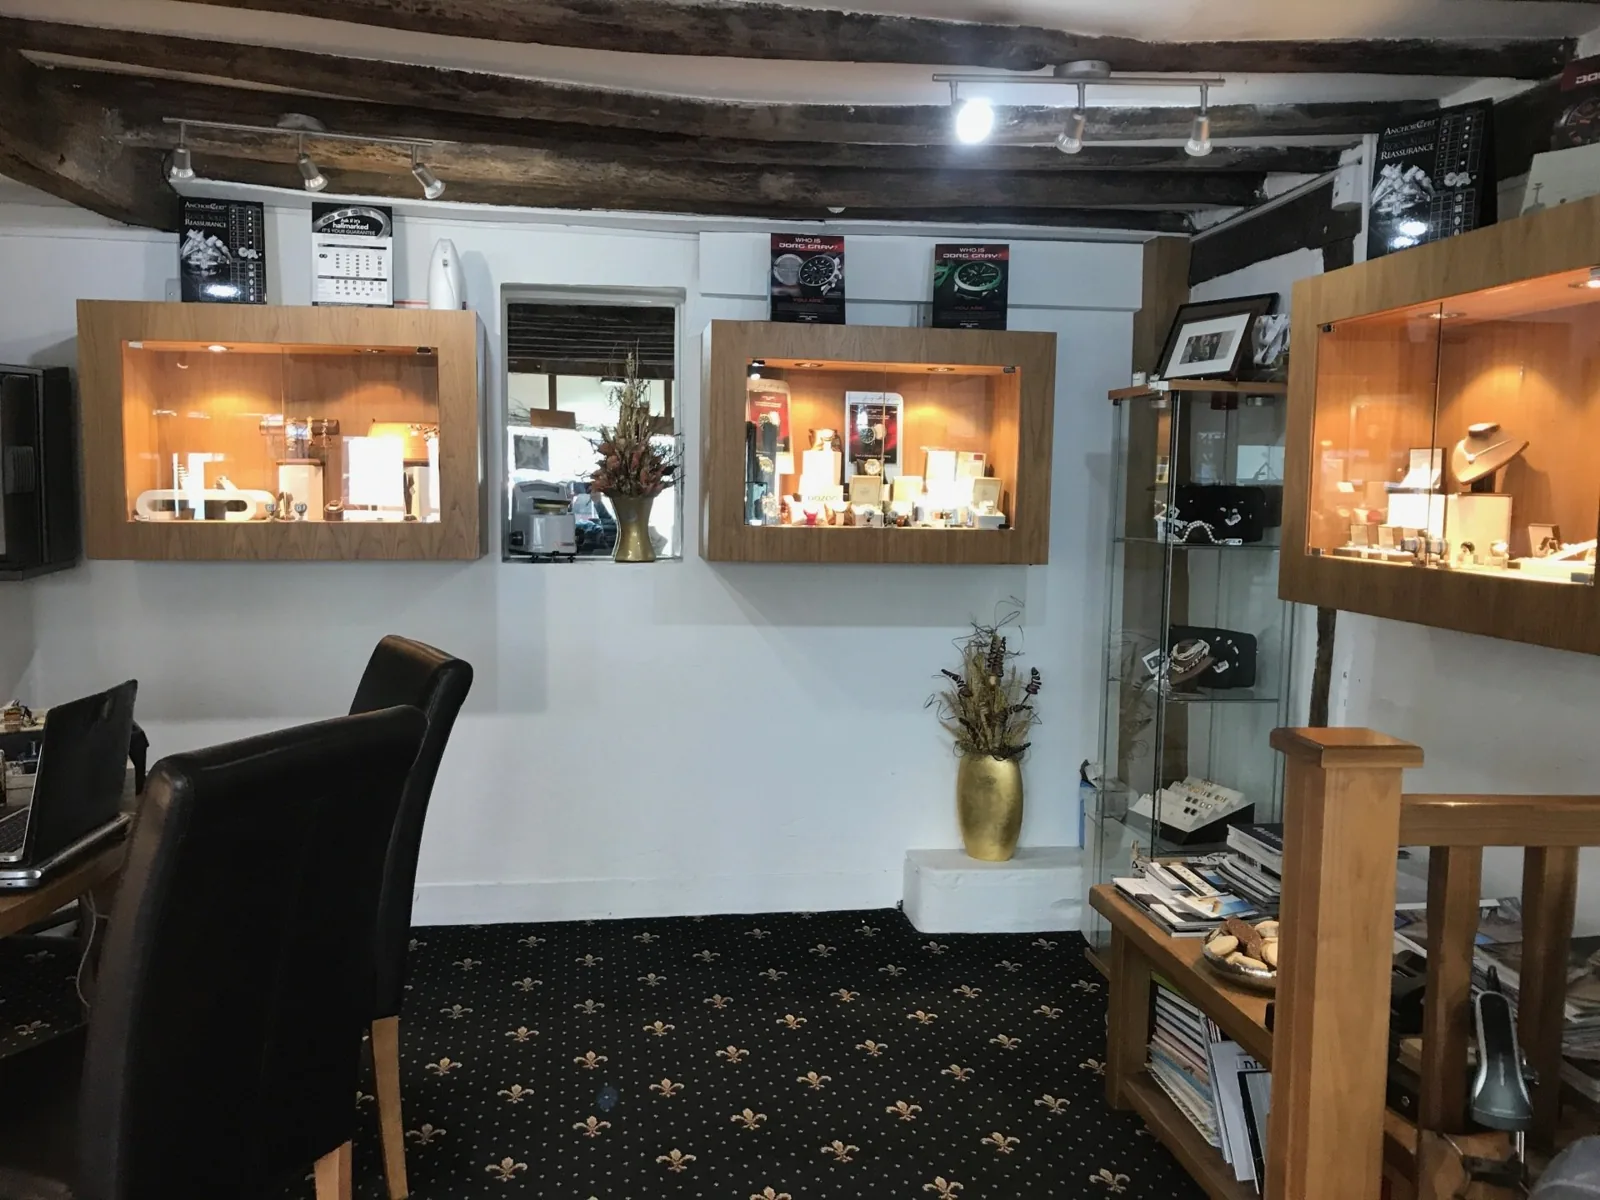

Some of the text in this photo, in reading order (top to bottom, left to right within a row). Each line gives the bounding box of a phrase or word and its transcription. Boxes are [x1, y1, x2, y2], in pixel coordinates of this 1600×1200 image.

[1381, 143, 1434, 160] REASSURANCE
[185, 219, 226, 228] REASSURANCE
[332, 222, 369, 230] hallmarked
